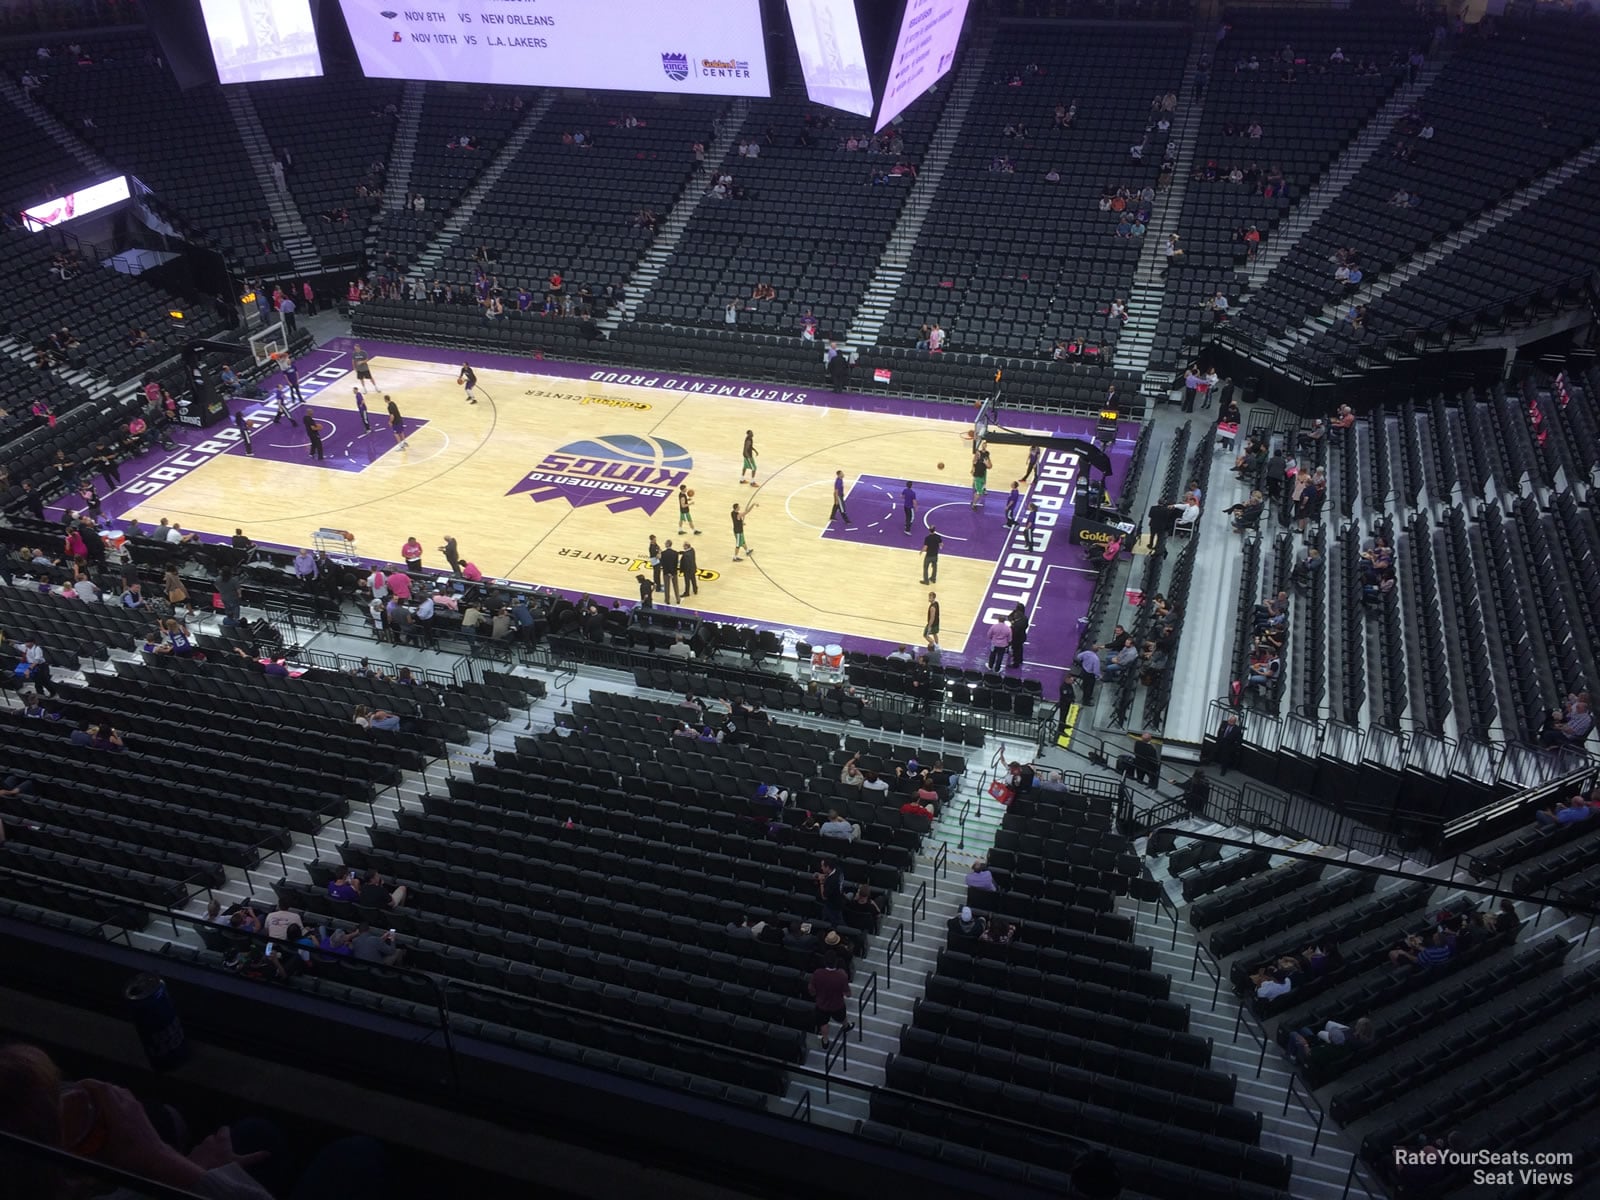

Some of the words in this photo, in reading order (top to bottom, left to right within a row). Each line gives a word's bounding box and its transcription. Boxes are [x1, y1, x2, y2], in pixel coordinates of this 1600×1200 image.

[404, 11, 425, 22] NOV
[426, 12, 446, 22] 8TH
[458, 13, 472, 23] VS
[481, 14, 504, 24] NEW
[507, 14, 555, 26] ORLEANS
[411, 32, 431, 43] NOV
[433, 34, 457, 44] 10TH
[464, 35, 478, 45] VS
[487, 36, 507, 46] L.A.
[508, 37, 548, 48] LAKERS
[703, 69, 750, 78] CENTER
[590, 371, 660, 388] PROUD
[524, 389, 582, 402] CENTER
[662, 378, 808, 404] SACRAMENTO
[535, 453, 689, 488] KINGS
[528, 472, 671, 498] SACRAMENTO
[557, 547, 631, 565] CENTER
